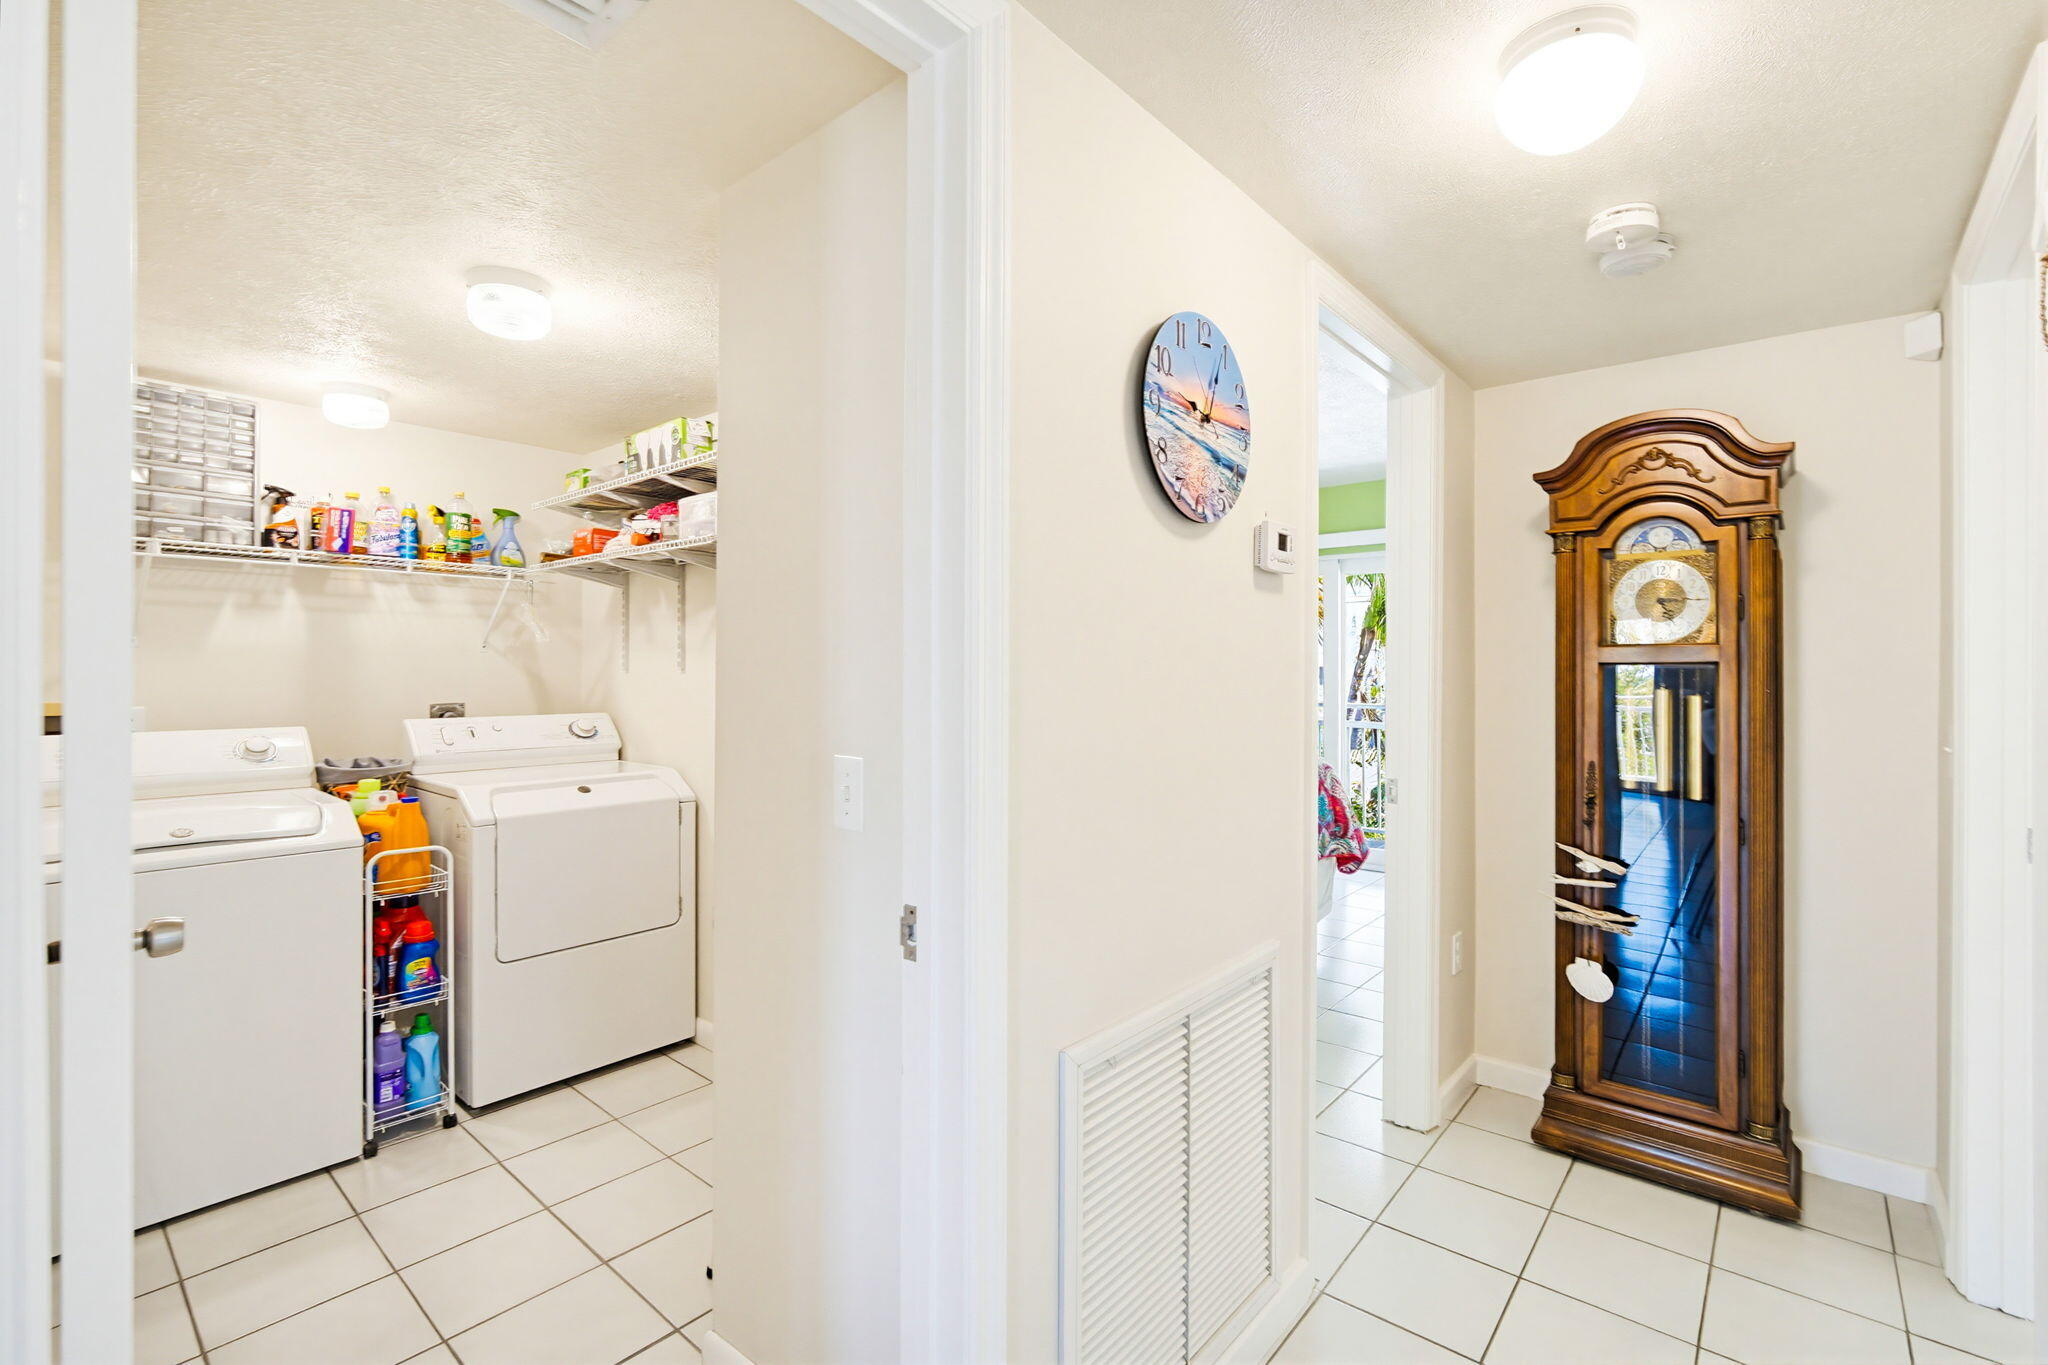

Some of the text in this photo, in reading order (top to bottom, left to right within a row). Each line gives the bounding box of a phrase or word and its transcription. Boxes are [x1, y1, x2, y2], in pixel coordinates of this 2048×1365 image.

[1176, 320, 1186, 349] 11
[1197, 319, 1211, 349] 12
[1155, 345, 1173, 377] 10
[1223, 345, 1228, 370] 1
[1149, 389, 1161, 416] 9
[1235, 384, 1245, 410] 2
[1157, 437, 1168, 464] 8
[1239, 427, 1248, 452] 3
[1231, 464, 1241, 488] 4
[1656, 565, 1666, 576] 12
